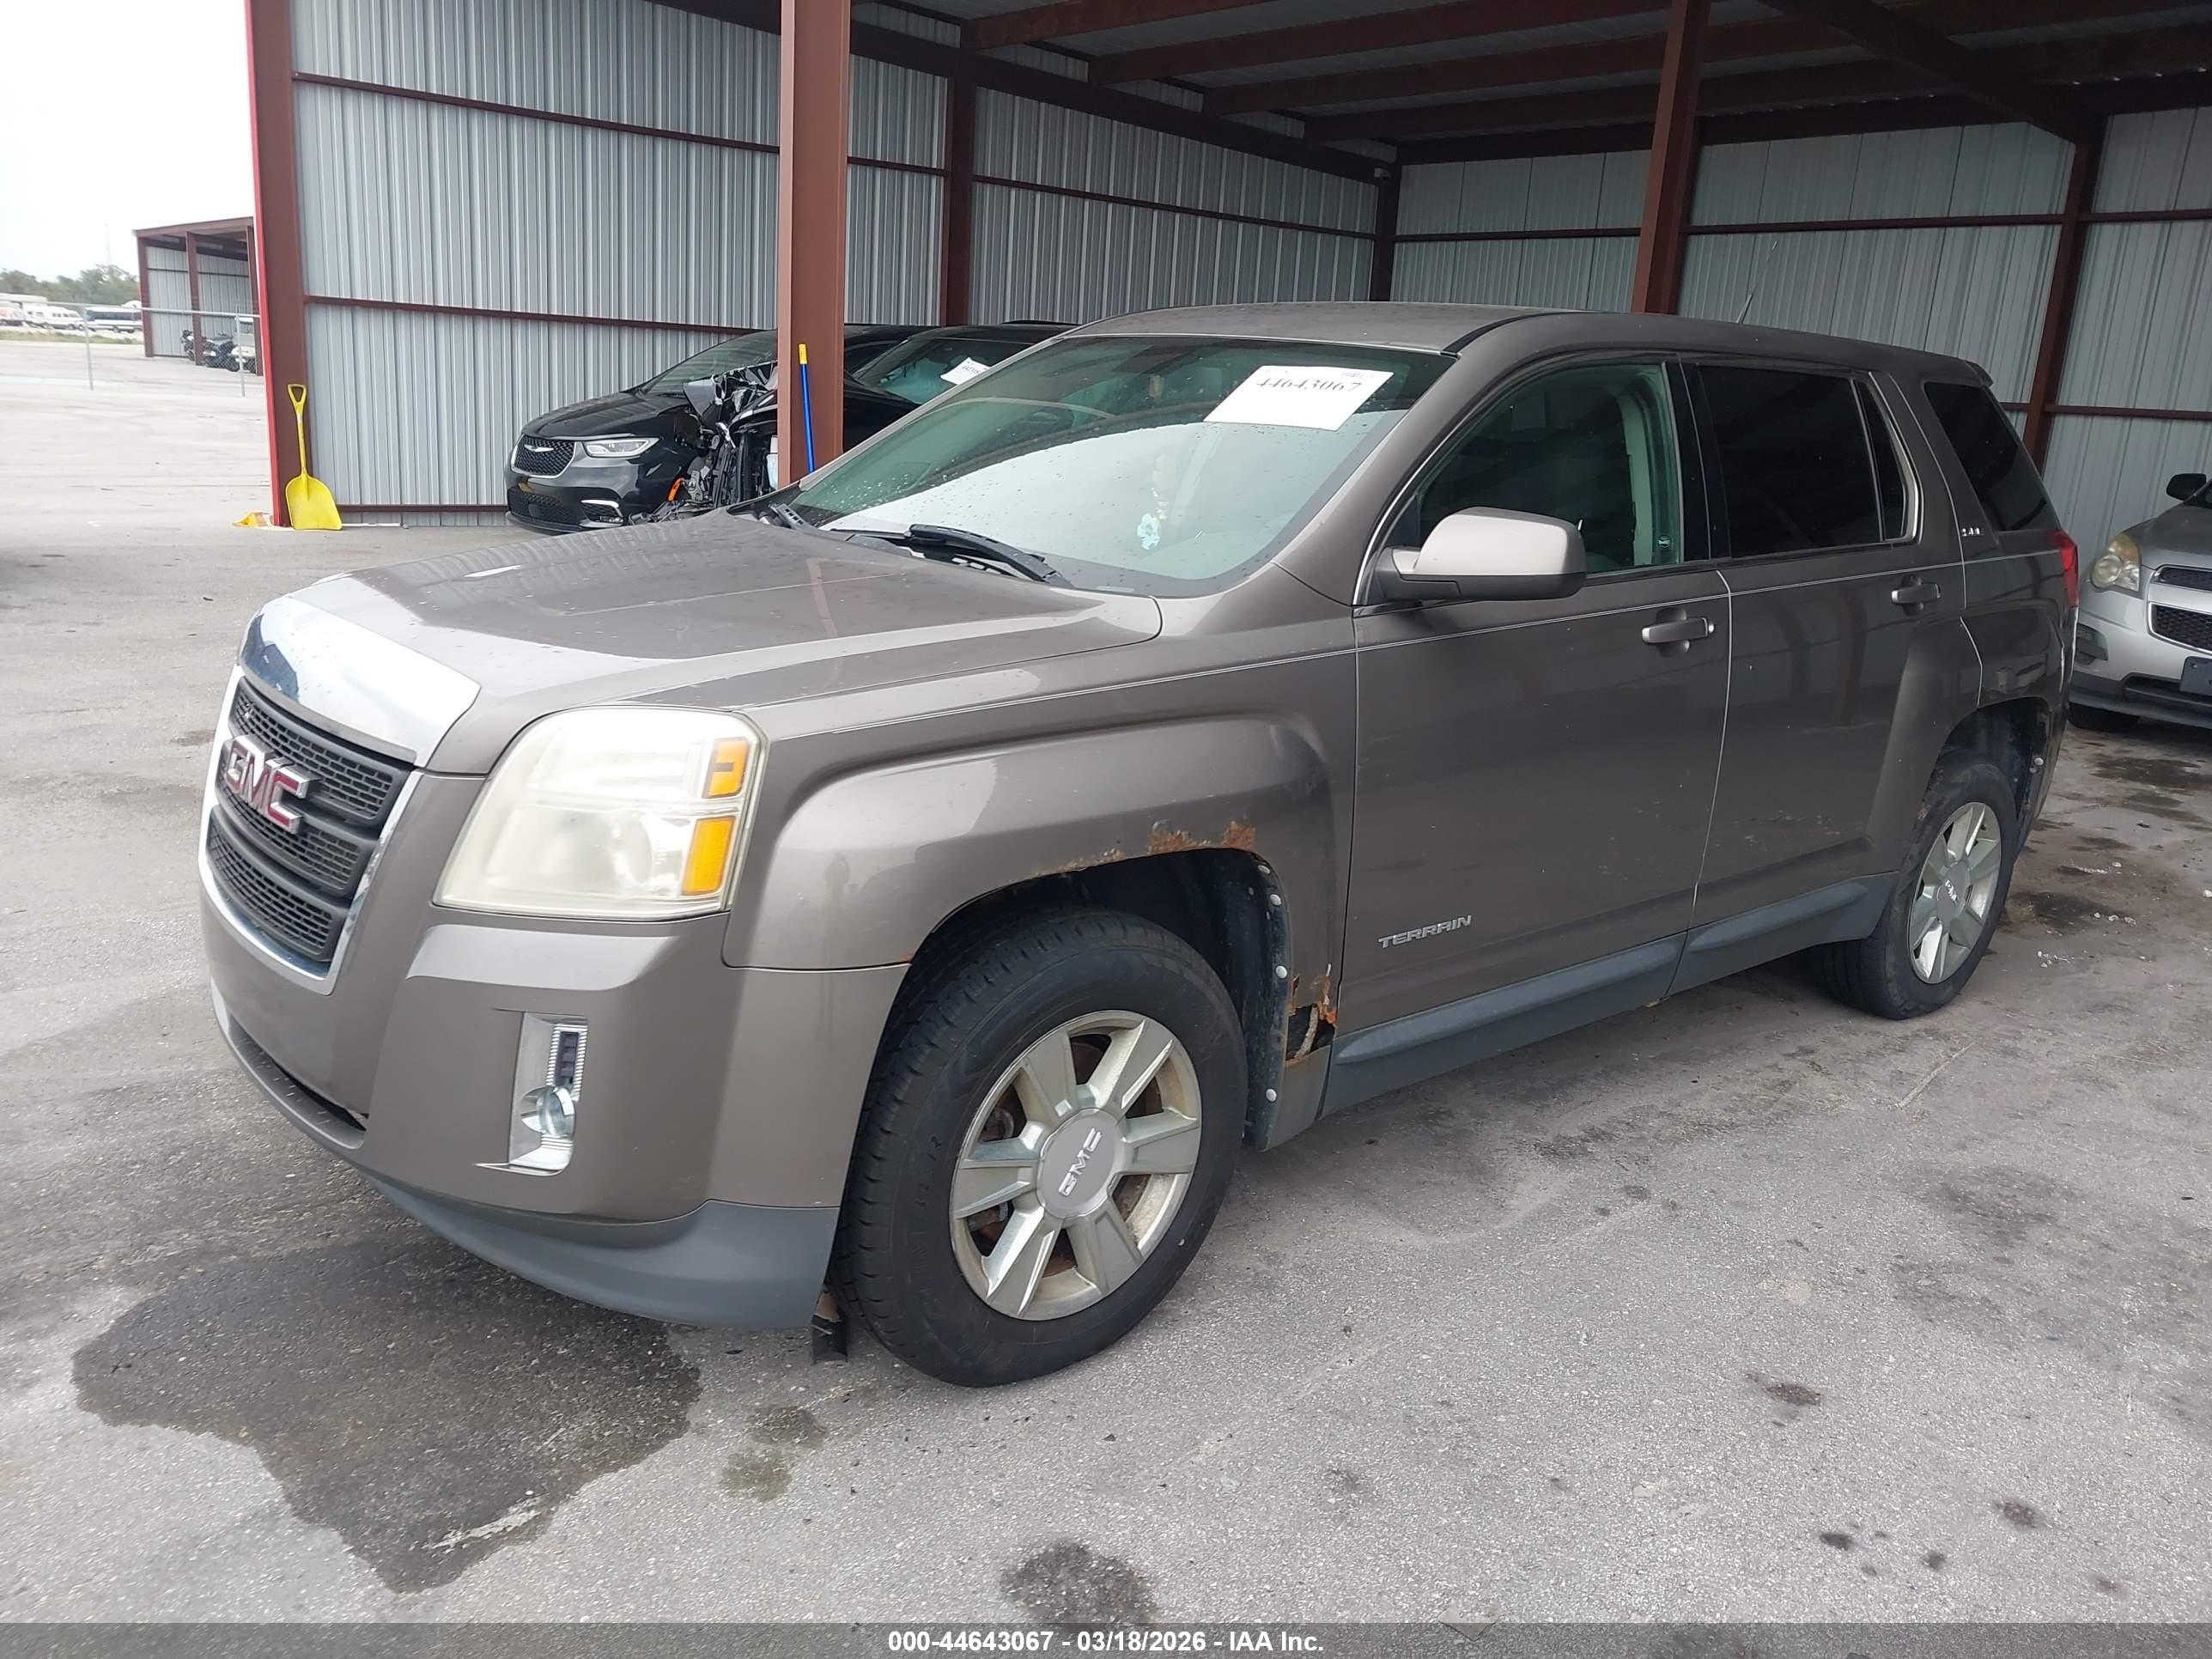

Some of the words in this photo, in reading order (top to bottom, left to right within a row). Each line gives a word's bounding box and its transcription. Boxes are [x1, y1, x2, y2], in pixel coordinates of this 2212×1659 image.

[1256, 378, 1363, 392] 44643067
[222, 733, 321, 835] GMC
[1377, 915, 1472, 949] TERRAIN
[1058, 1127, 1102, 1196] GMC
